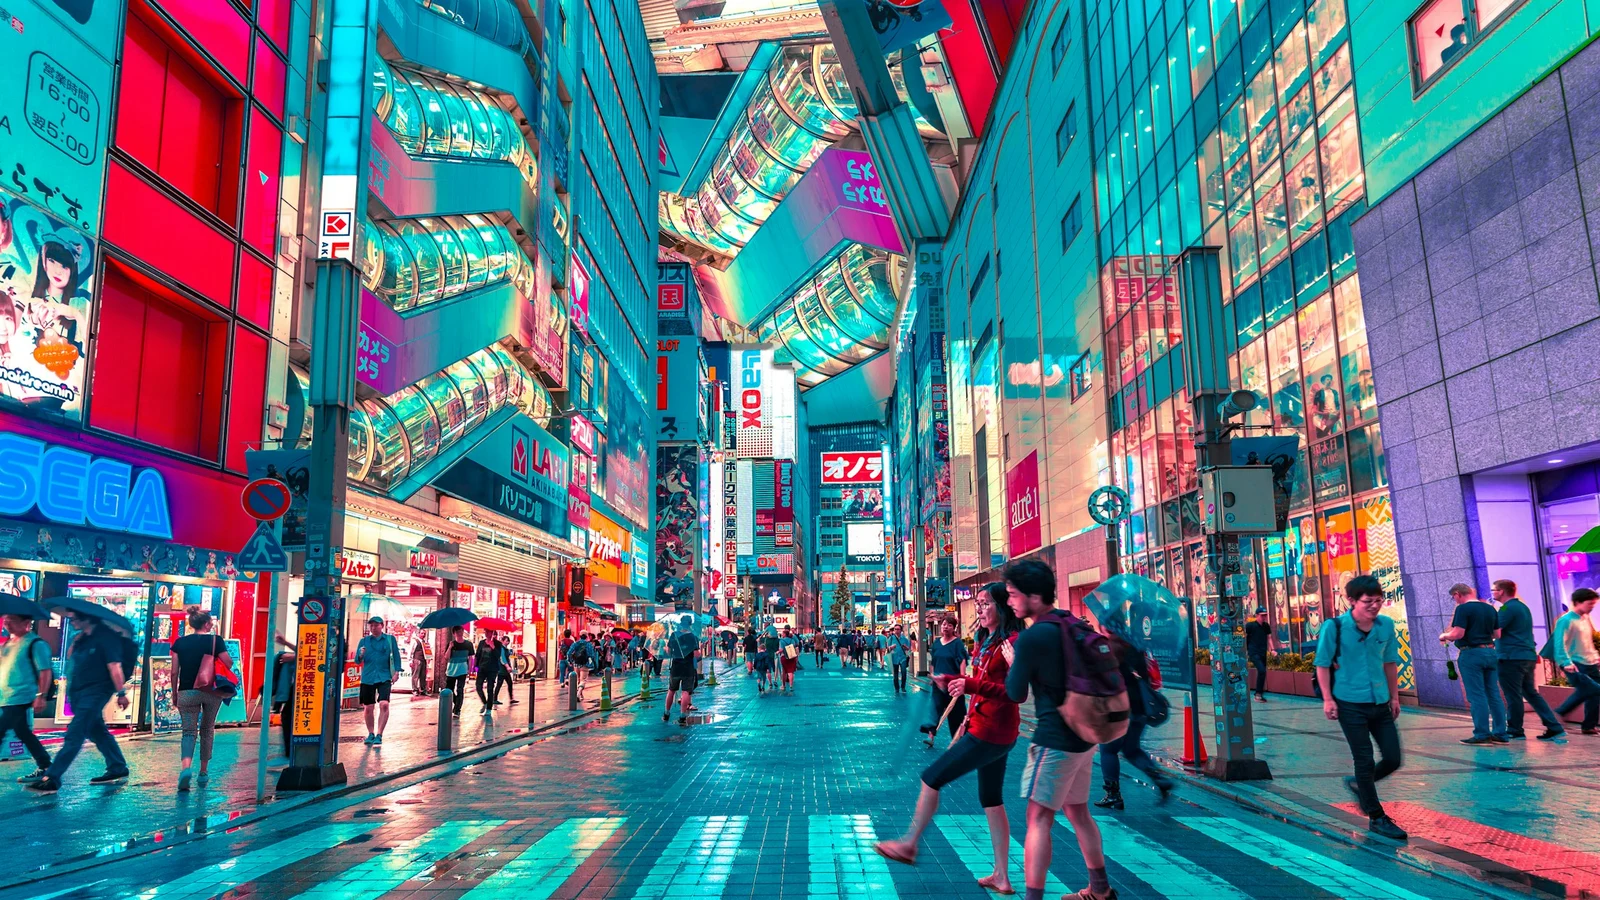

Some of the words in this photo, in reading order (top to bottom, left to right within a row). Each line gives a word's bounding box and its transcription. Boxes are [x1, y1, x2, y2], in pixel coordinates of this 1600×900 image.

[38, 74, 90, 123] 16:00
[43, 61, 89, 105] 営業時間
[32, 111, 89, 159] 翌5:00
[0, 162, 90, 230] らです。
[320, 241, 328, 260] AK
[358, 331, 390, 364] カメラ
[532, 438, 567, 490] LABI
[780, 462, 792, 485] Duty
[0, 432, 172, 539] SEGA
[499, 483, 543, 525] パソコン館
[531, 475, 567, 506] AKIHABARA
[780, 486, 792, 508] Free
[1011, 486, 1032, 527] atré
[419, 551, 437, 568] LABI
[301, 632, 317, 732] 路上喫煙禁止です。
[347, 666, 362, 677] au
